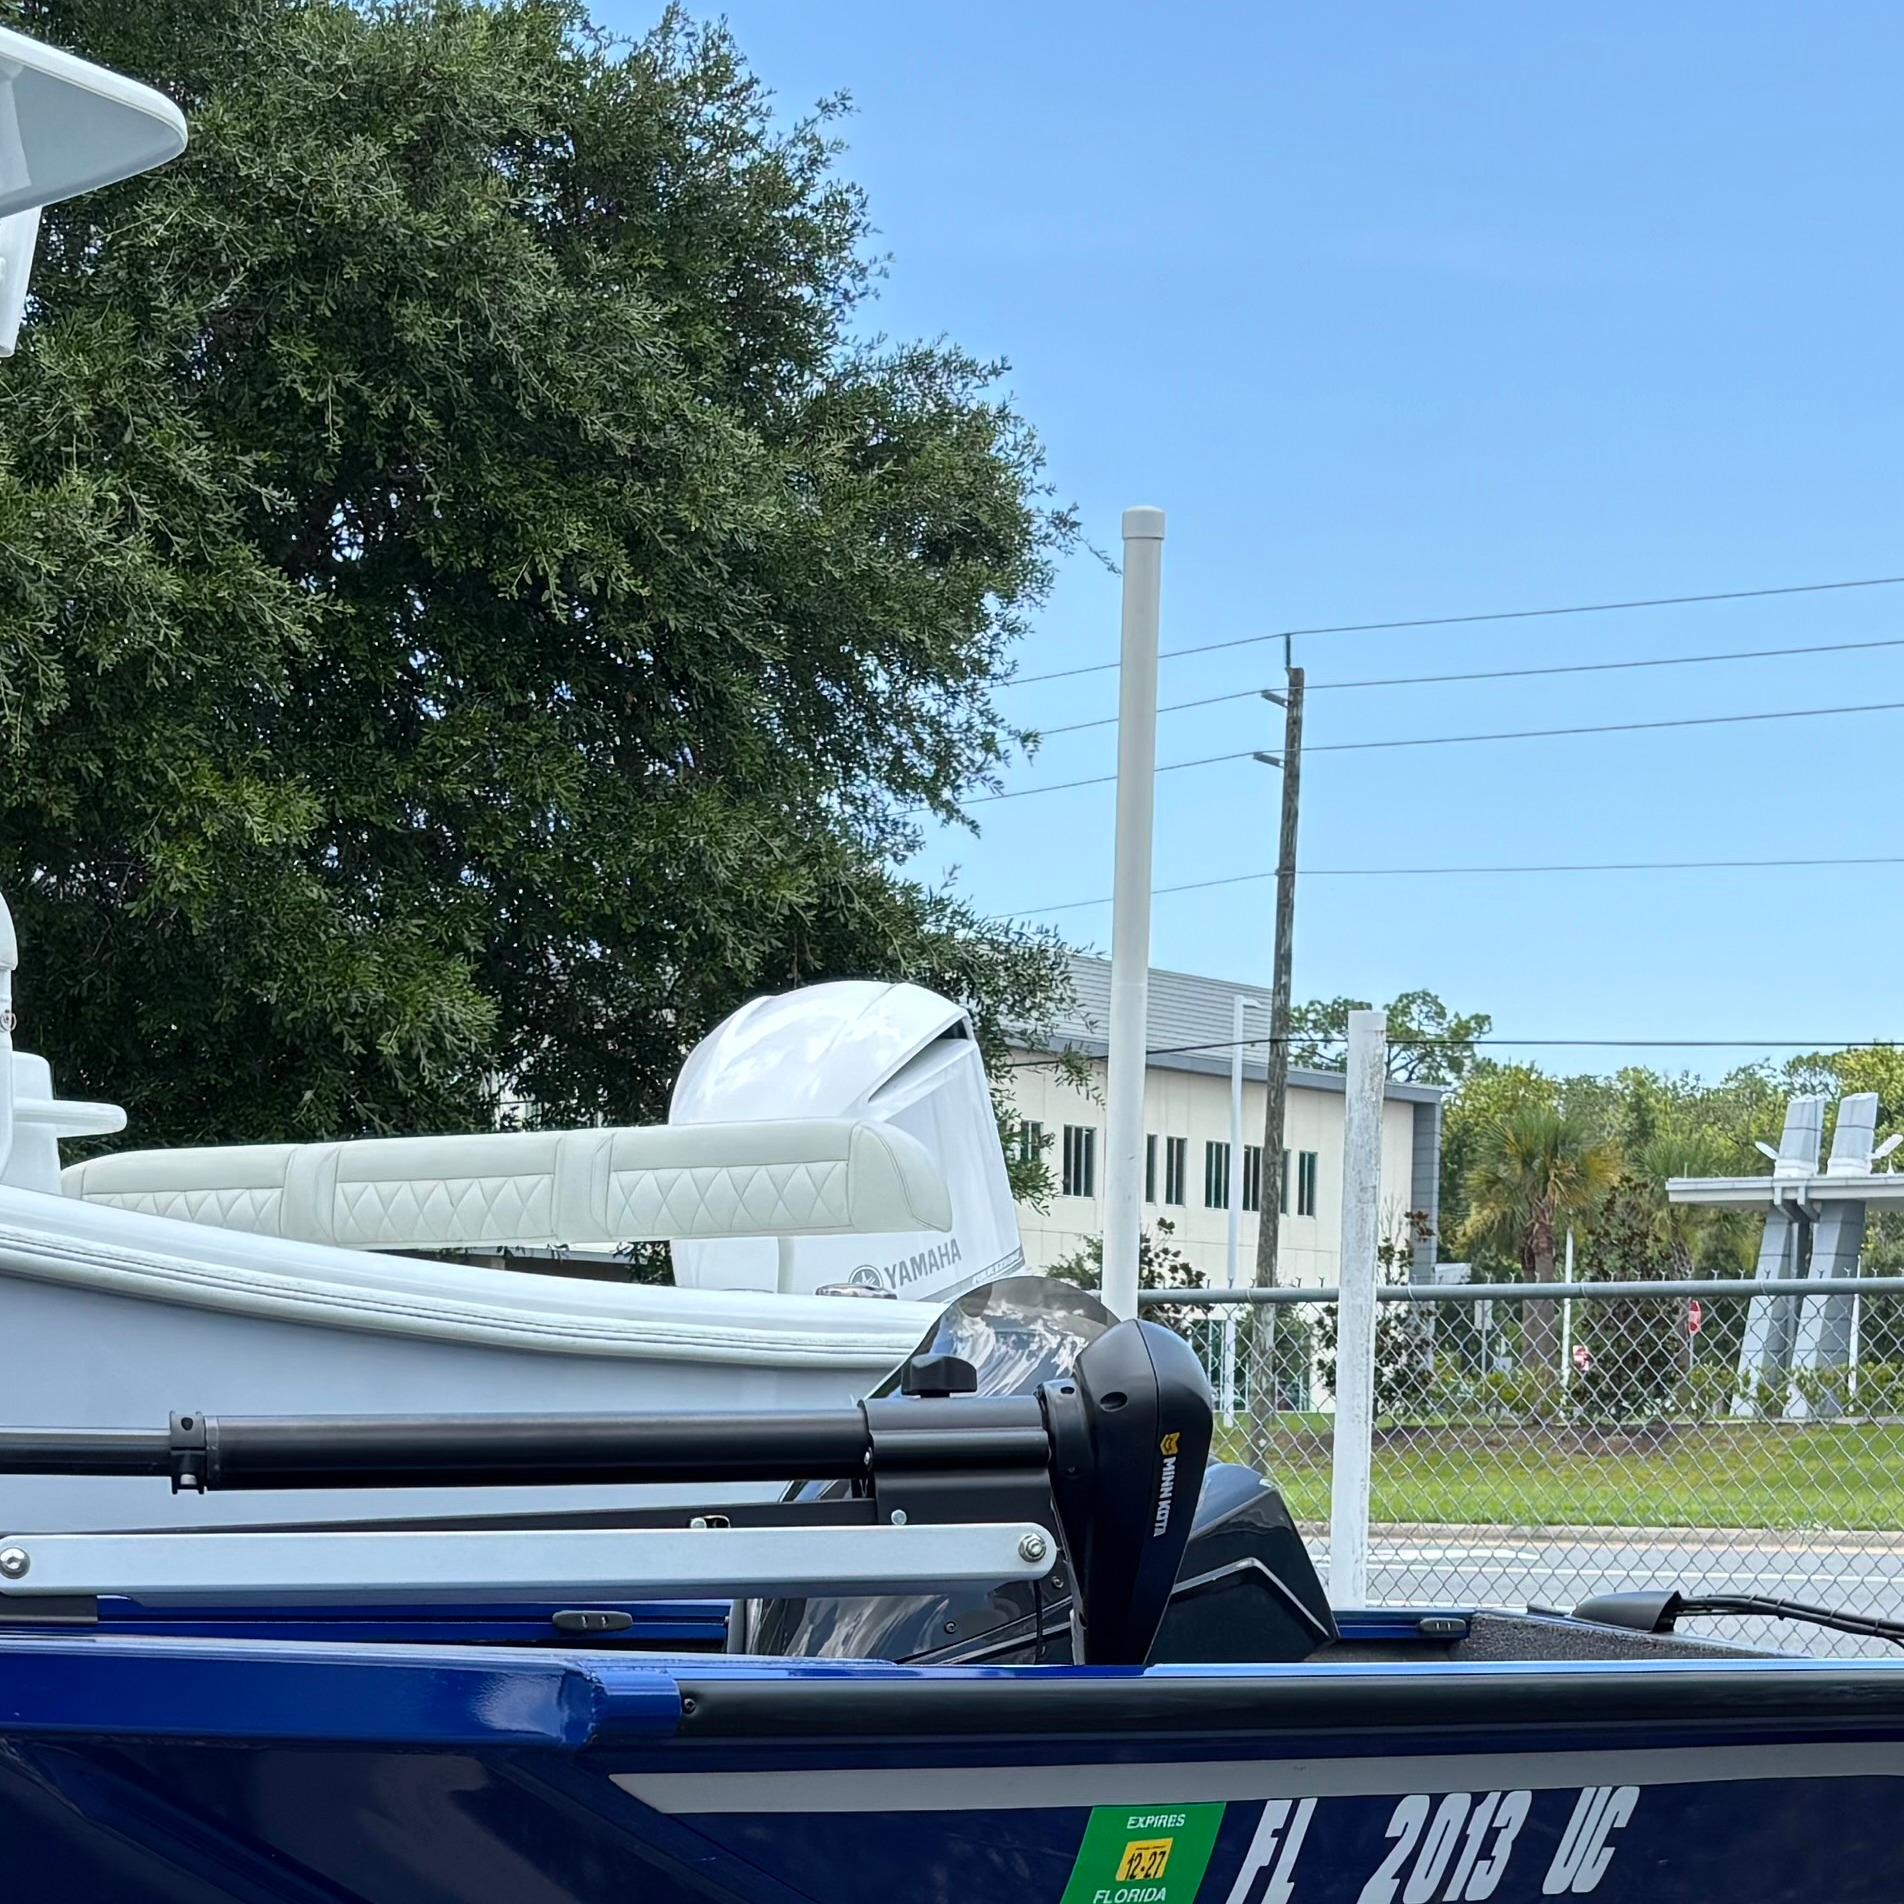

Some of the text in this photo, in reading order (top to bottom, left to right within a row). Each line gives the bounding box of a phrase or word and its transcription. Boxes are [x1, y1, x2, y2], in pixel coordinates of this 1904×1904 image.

[883, 1238, 963, 1290] YAMAHA
[1153, 1456, 1177, 1537] MINN KOTA
[1126, 1814, 1186, 1830] EXPIRES
[1542, 1786, 1640, 1895] UC
[1092, 1886, 1167, 1904] FLORIDA
